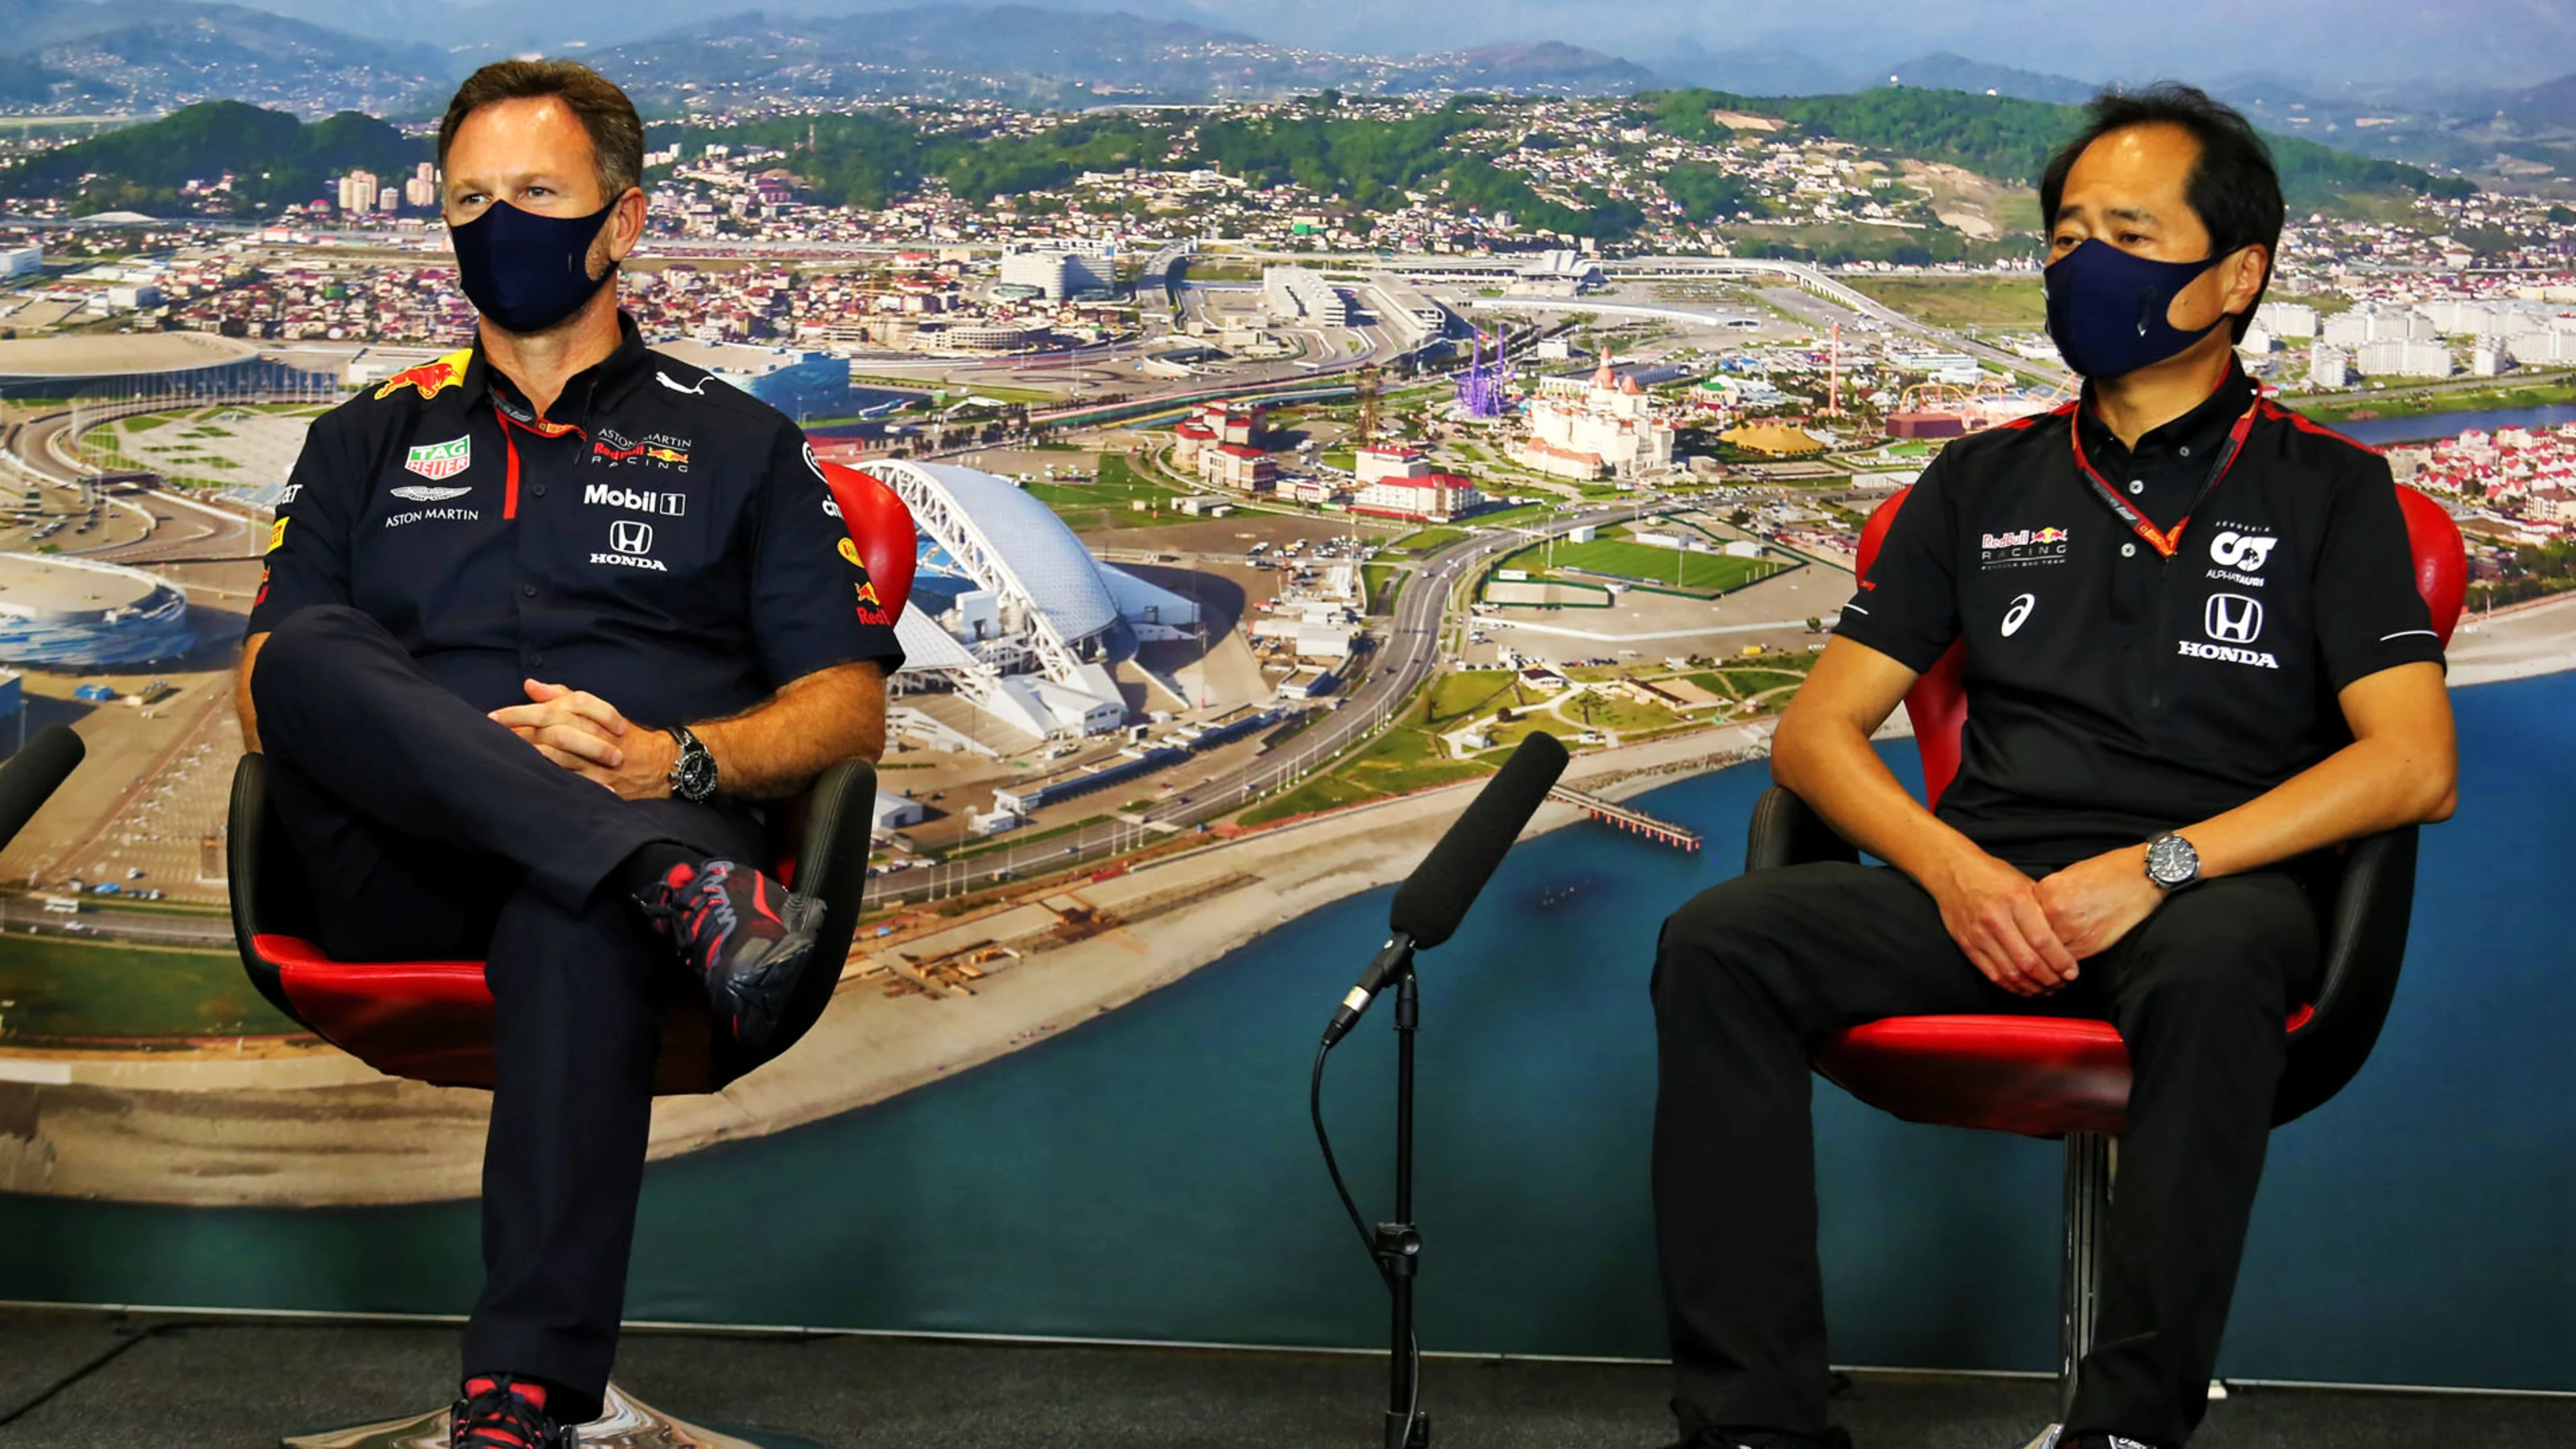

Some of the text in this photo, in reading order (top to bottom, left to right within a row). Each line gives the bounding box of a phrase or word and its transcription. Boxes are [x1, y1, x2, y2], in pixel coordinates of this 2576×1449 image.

[415, 440, 466, 460] TAG
[409, 457, 467, 477] HEUER
[591, 456, 689, 473] RACING
[584, 483, 657, 514] Mobil
[386, 508, 479, 528] ASTON MARTIN
[1982, 544, 2066, 559] RACING
[589, 553, 667, 572] HONDA
[2178, 640, 2280, 669] HONDA
